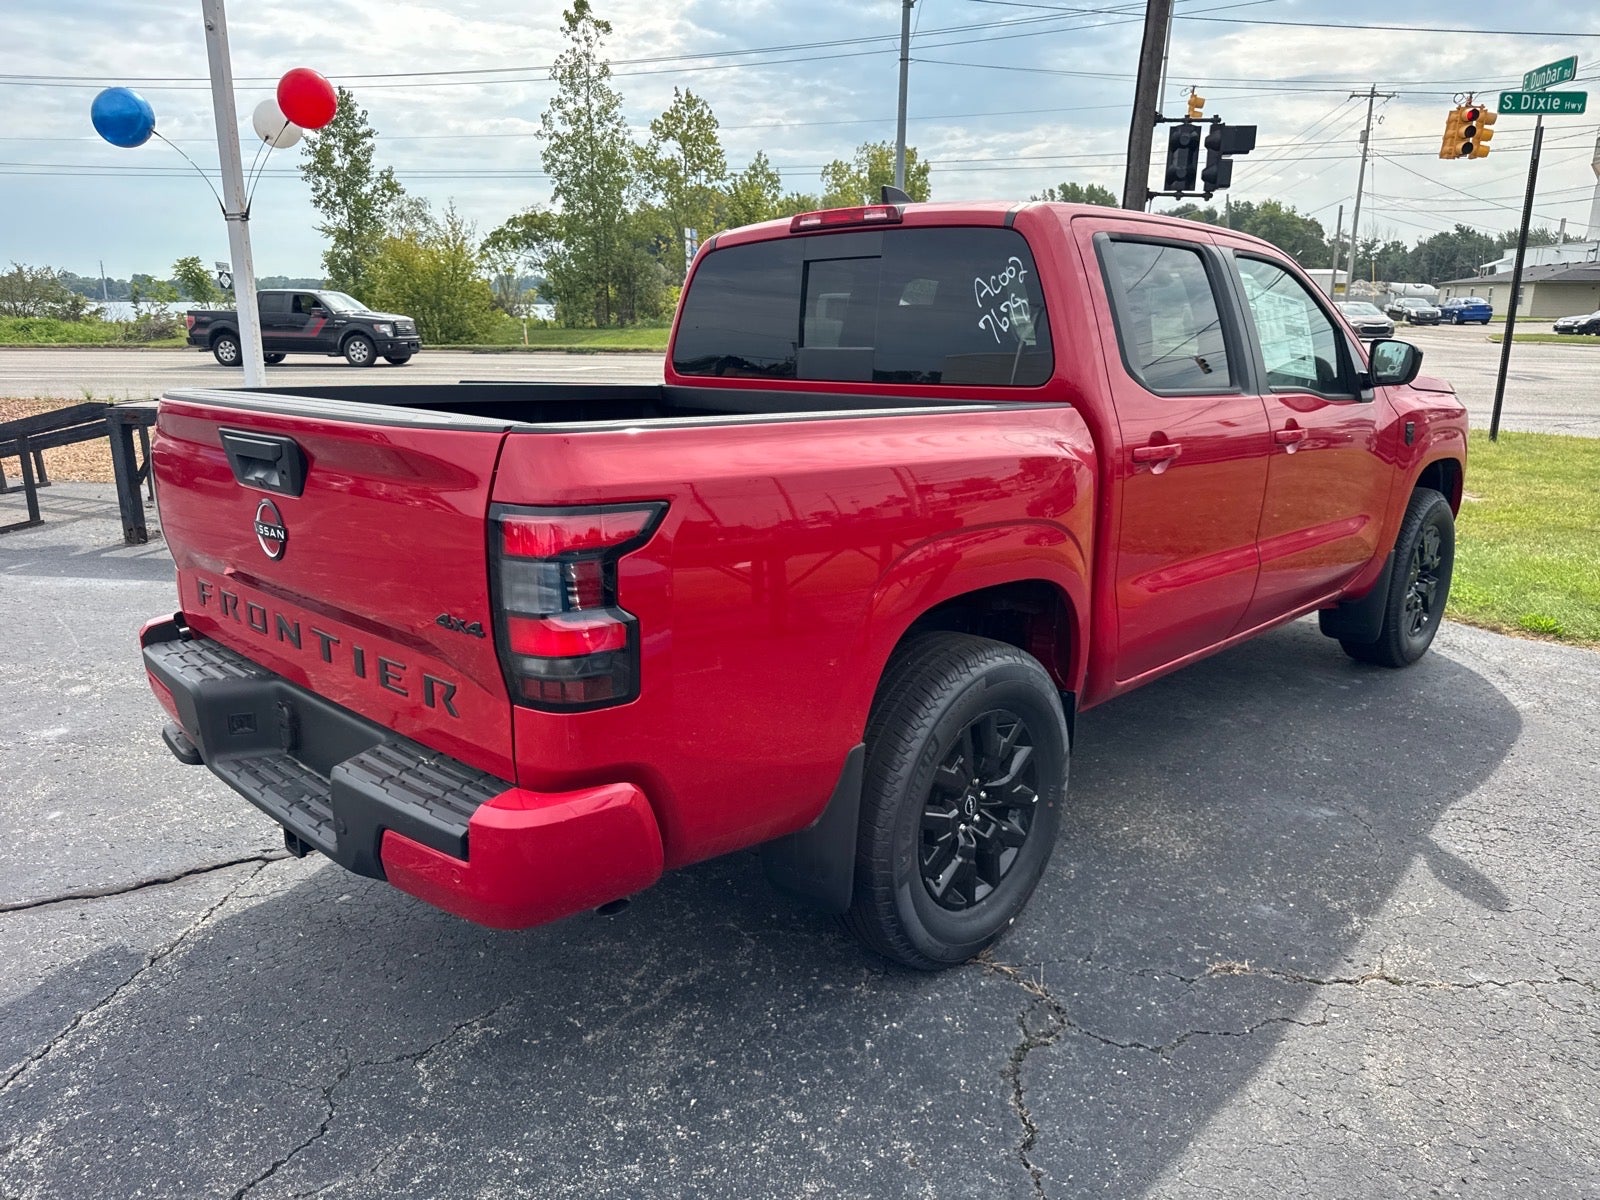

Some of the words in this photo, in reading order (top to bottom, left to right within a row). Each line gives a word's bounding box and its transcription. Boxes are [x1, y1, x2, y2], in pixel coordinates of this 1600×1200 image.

[1530, 66, 1563, 89] Dunbar
[1502, 94, 1515, 110] S.
[1520, 94, 1561, 110] Dixie
[1564, 101, 1582, 111] Hwy
[256, 523, 285, 540] SSAN
[196, 579, 460, 719] FRONTIER
